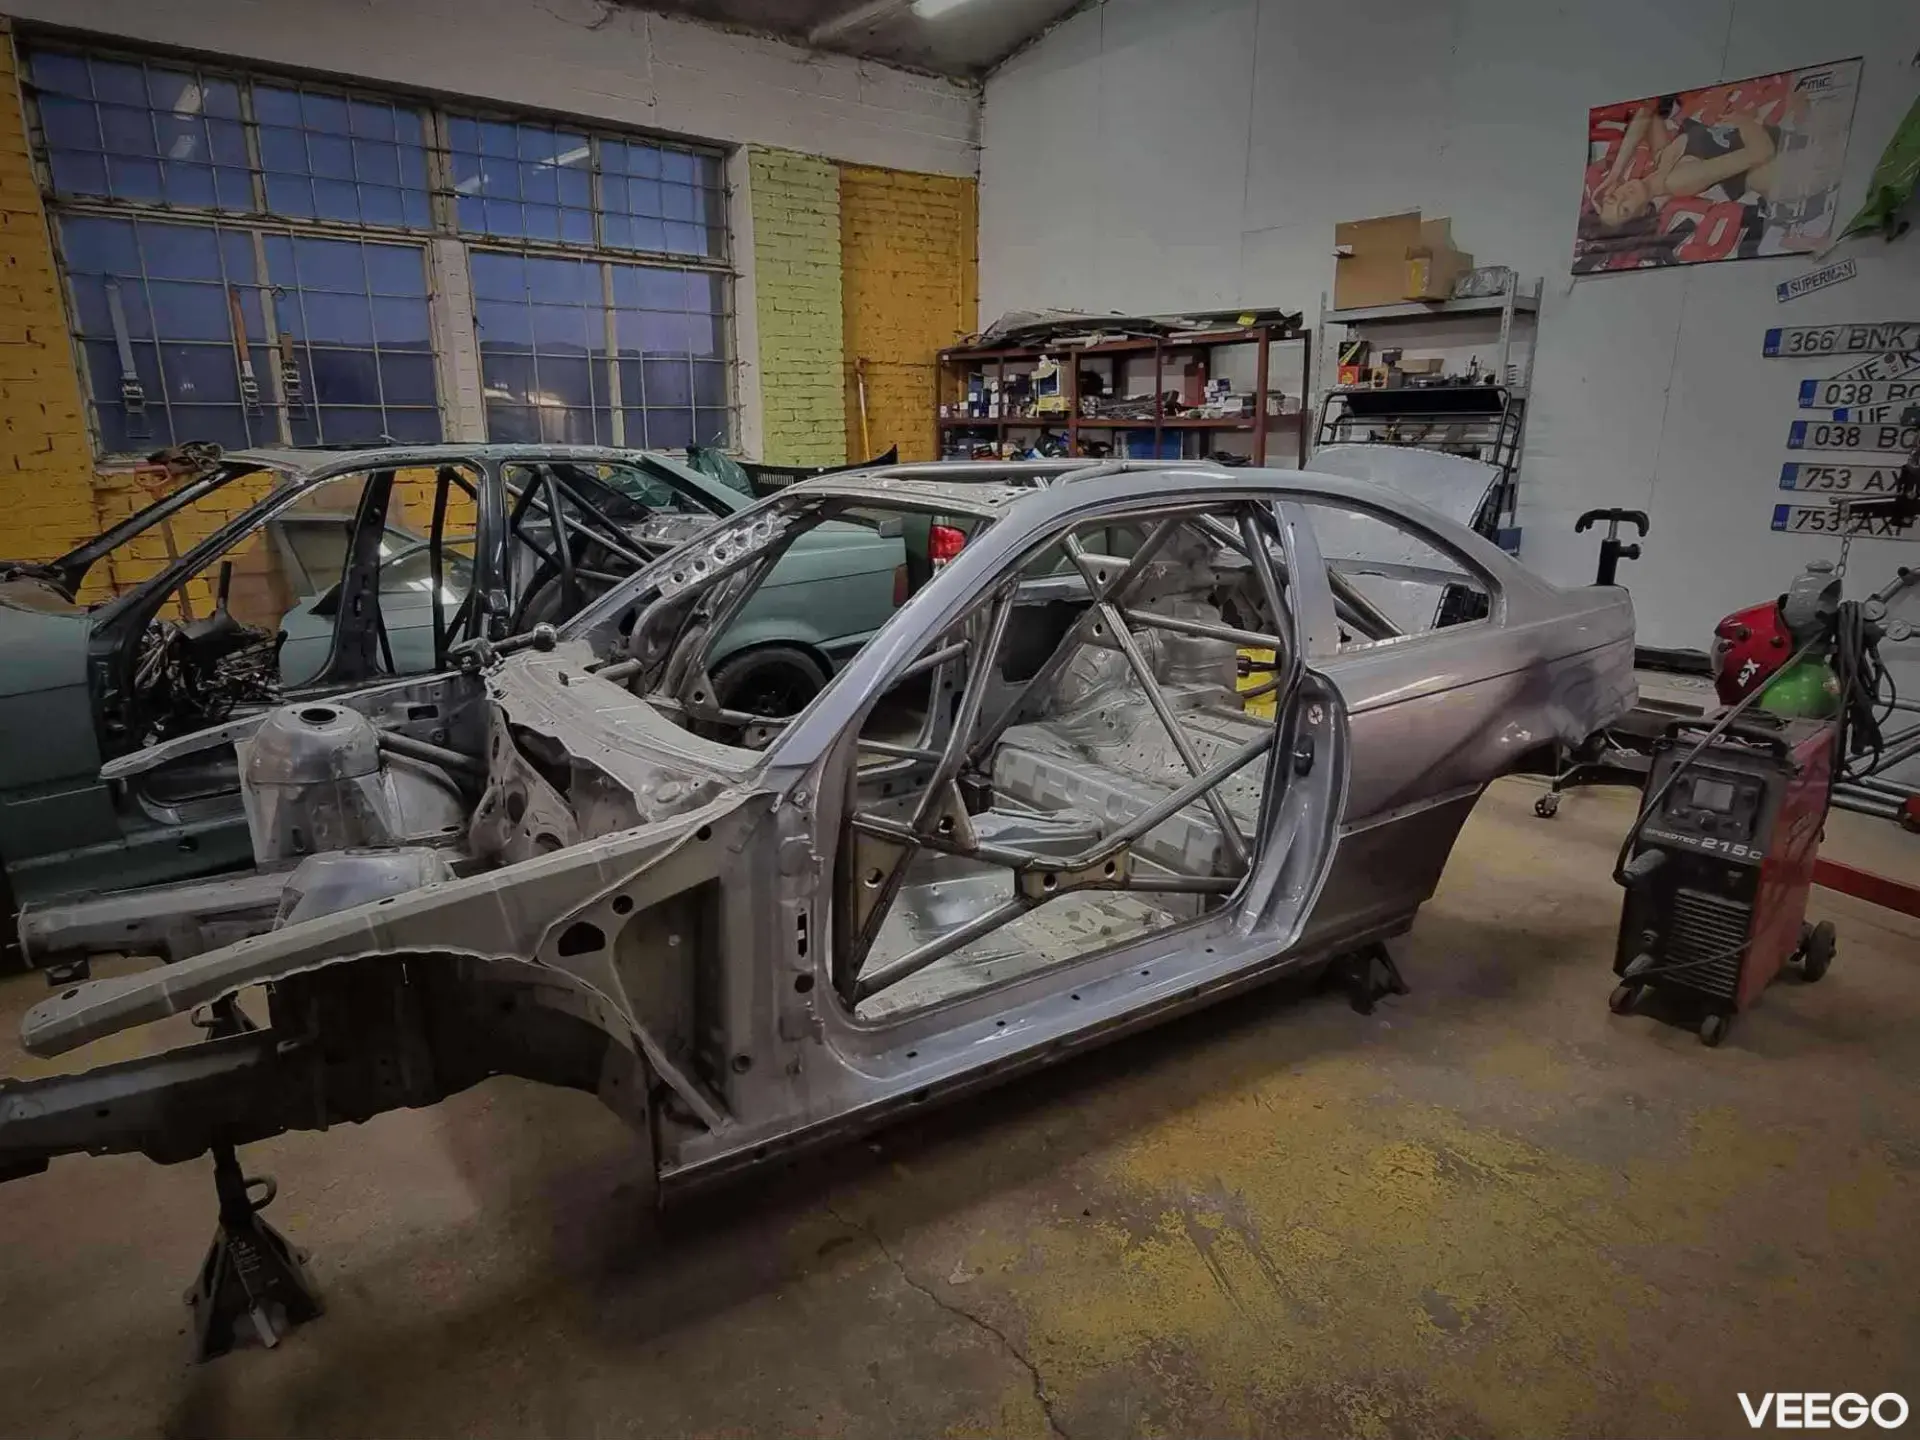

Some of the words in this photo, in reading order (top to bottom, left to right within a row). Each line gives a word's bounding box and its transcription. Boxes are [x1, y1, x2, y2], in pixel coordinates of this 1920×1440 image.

[1790, 261, 1853, 294] SUPERMAN
[1789, 330, 1836, 352] 366
[1848, 325, 1910, 350] BNK
[1825, 384, 1873, 404] 038
[1815, 426, 1861, 447] 038
[1805, 468, 1852, 490] 753
[1795, 510, 1840, 531] 753
